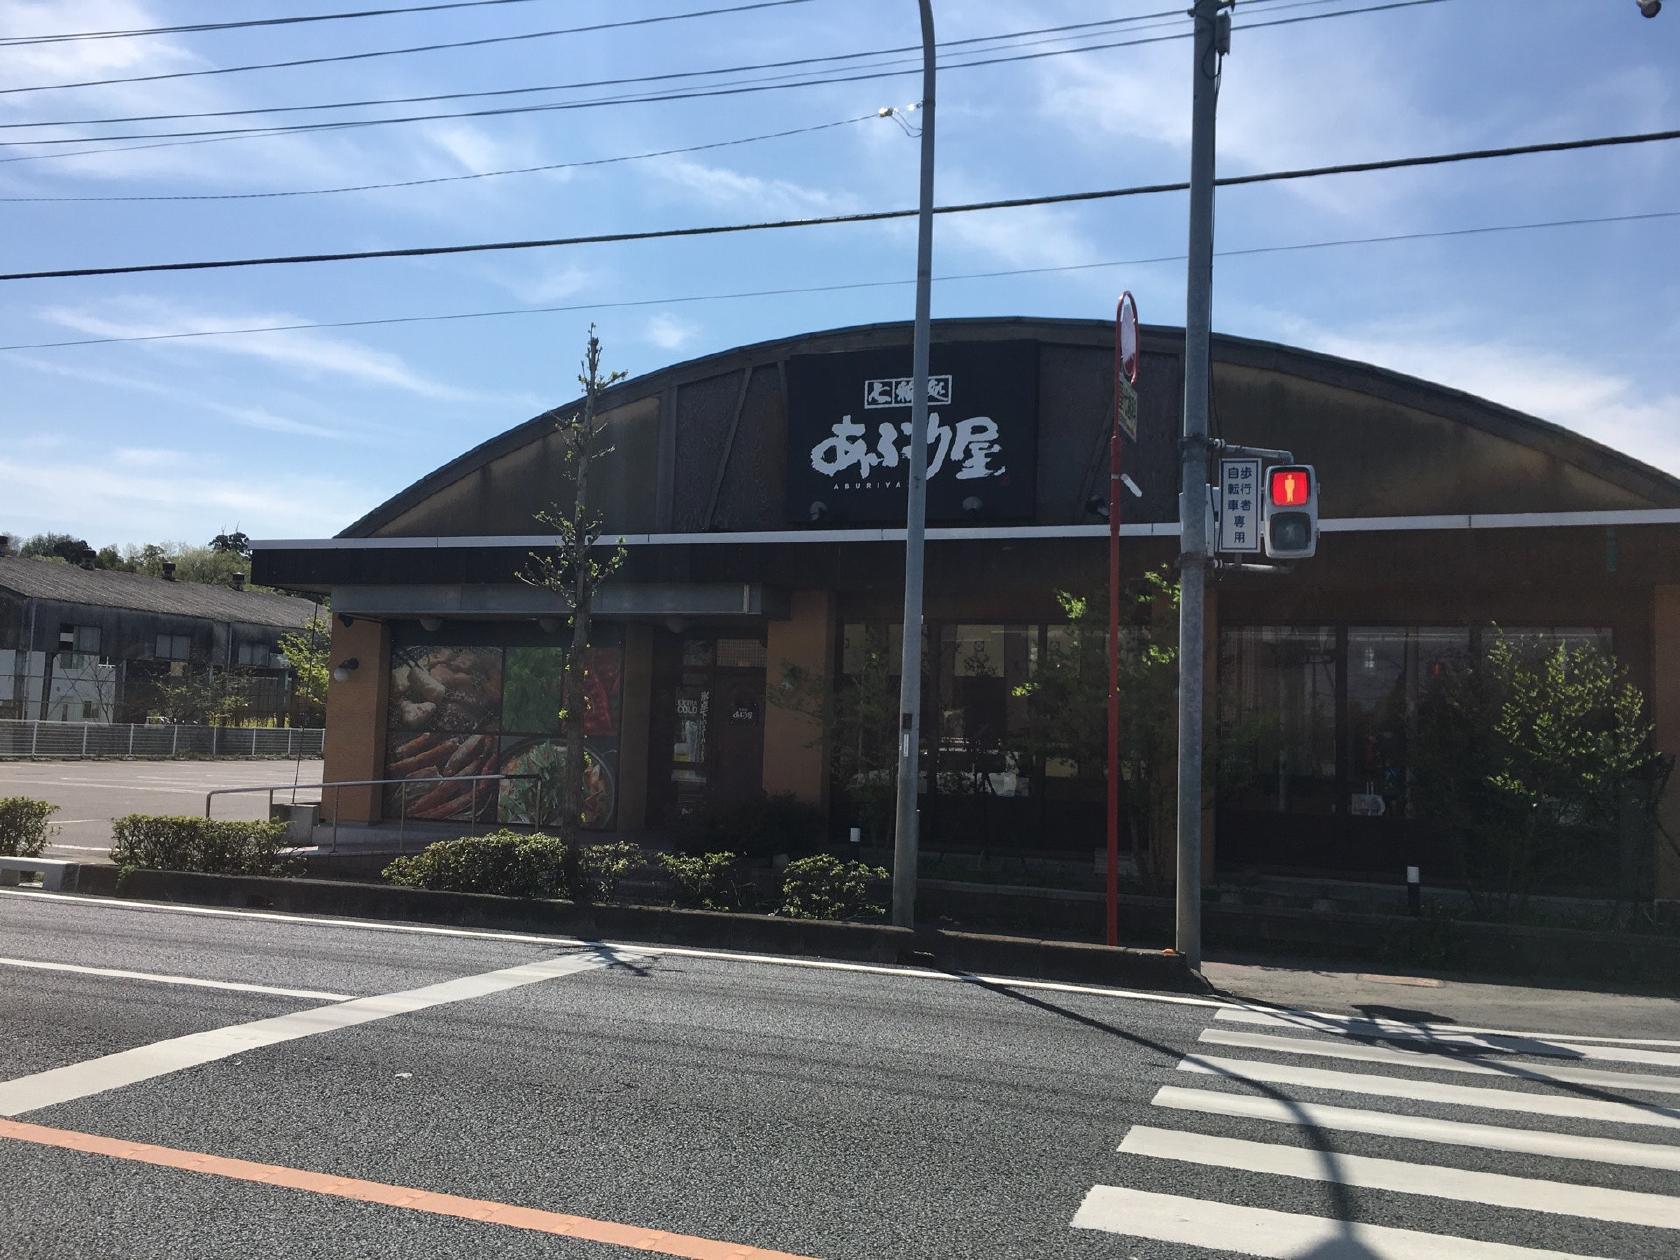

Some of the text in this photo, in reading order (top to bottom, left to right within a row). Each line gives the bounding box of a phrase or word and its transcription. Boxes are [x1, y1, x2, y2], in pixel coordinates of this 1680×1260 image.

[833, 481, 901, 490] ABURIYA
[1227, 467, 1239, 511] 自転車
[1240, 466, 1253, 511] 歩行者
[1233, 515, 1246, 543] 専用
